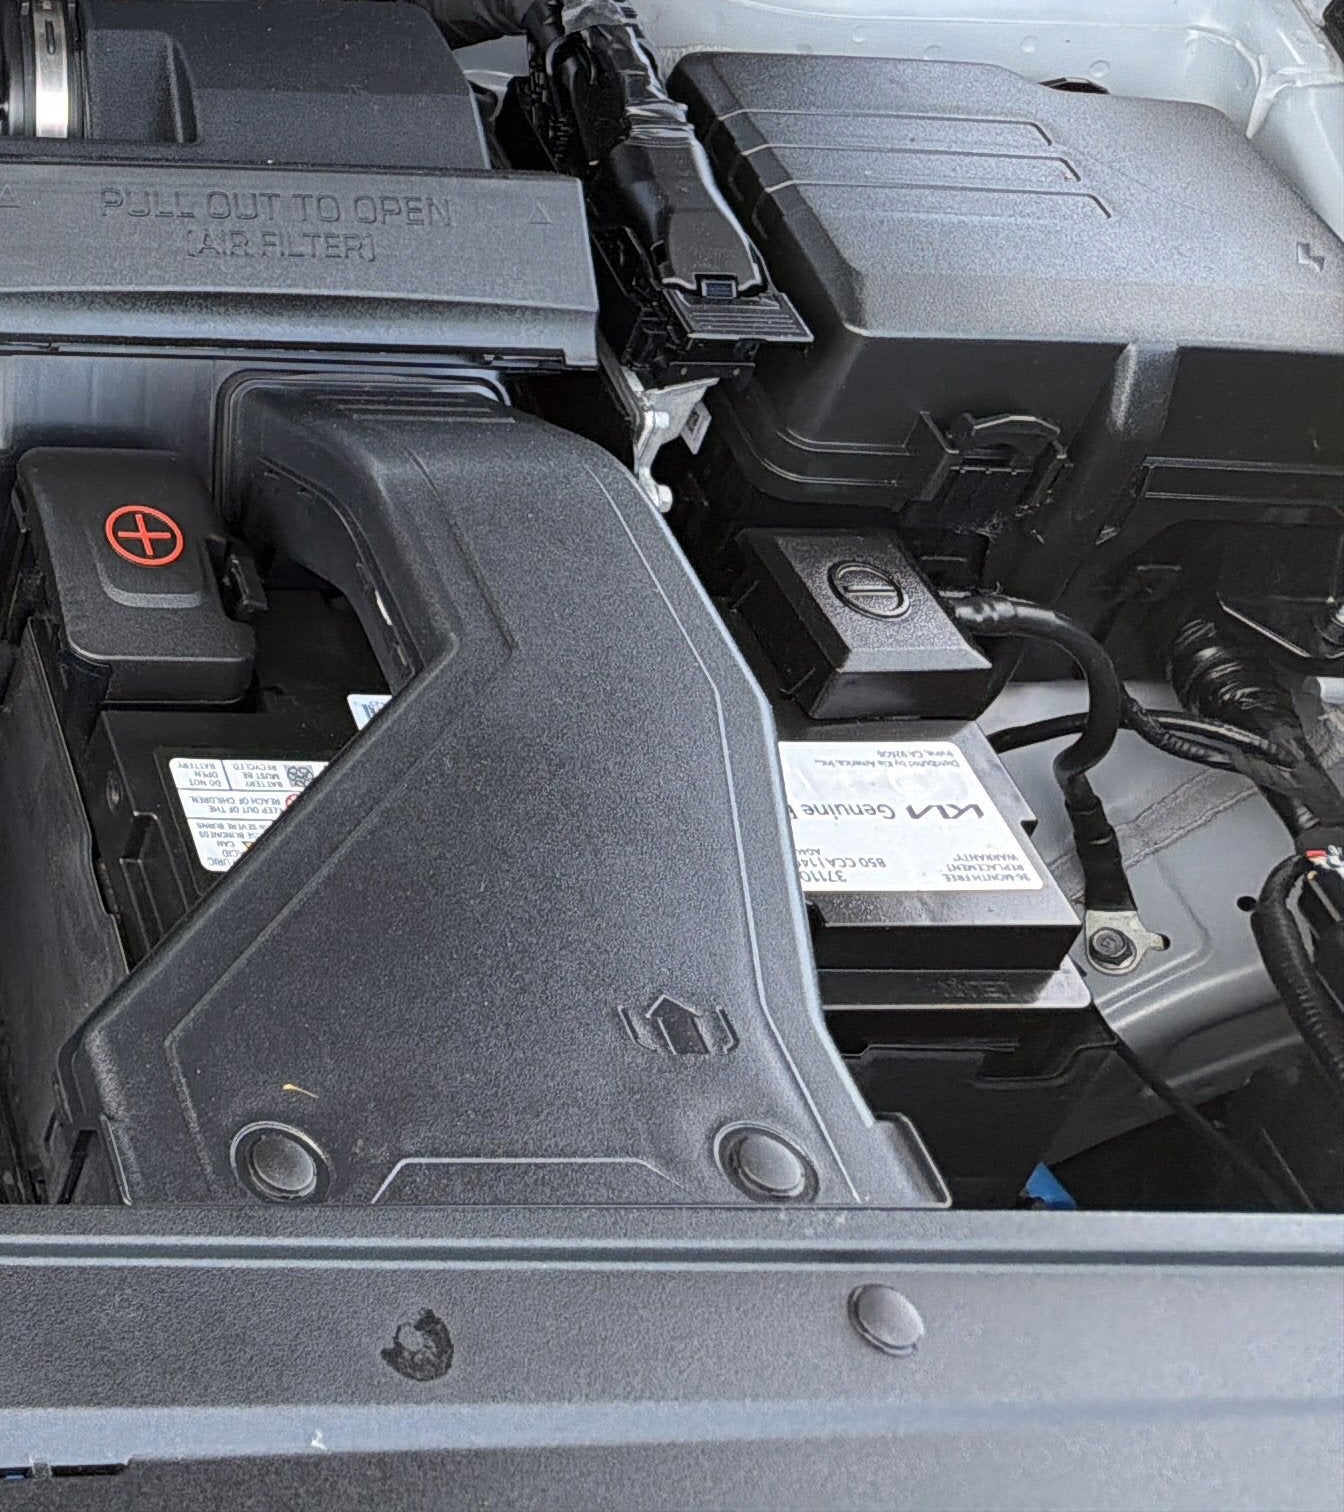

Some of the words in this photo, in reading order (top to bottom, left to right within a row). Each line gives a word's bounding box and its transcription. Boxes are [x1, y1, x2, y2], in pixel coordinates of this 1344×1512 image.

[99, 187, 195, 219] PULL
[206, 190, 283, 221] OUT
[294, 192, 341, 223] TO
[354, 194, 454, 228] OPEN
[233, 763, 277, 771] RECYCLED
[255, 772, 280, 780] MUST
[189, 779, 208, 787] NOT
[245, 780, 283, 788] BATTERY
[242, 806, 259, 814] OUT
[800, 803, 896, 820] Genuine
[905, 803, 985, 820] KIA
[196, 822, 225, 830] BURNS
[221, 849, 243, 857] CID
[826, 857, 857, 868] CCA
[858, 857, 887, 868] 850
[946, 863, 1025, 872] REPLACEMENT
[942, 873, 971, 882] FREE
